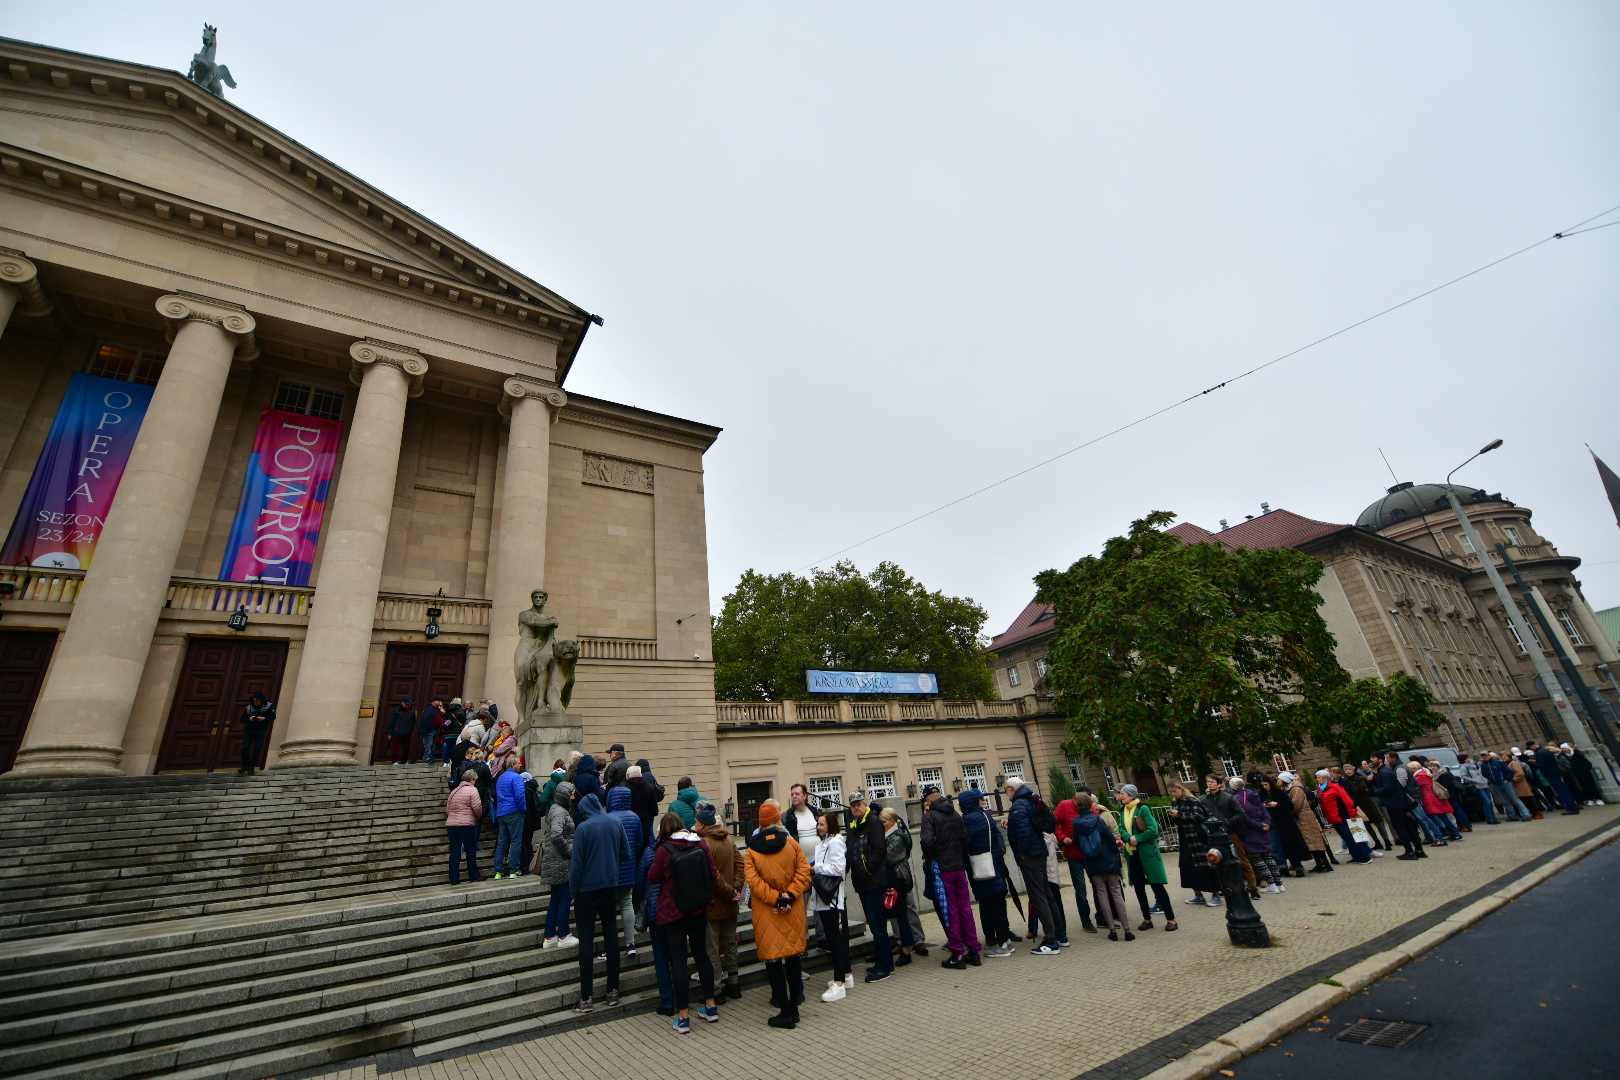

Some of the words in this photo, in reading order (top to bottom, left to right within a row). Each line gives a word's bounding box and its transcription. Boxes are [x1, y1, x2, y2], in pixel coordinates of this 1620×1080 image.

[67, 391, 132, 503] OPERA
[36, 510, 104, 527] SEZON
[37, 527, 94, 544] 23/24
